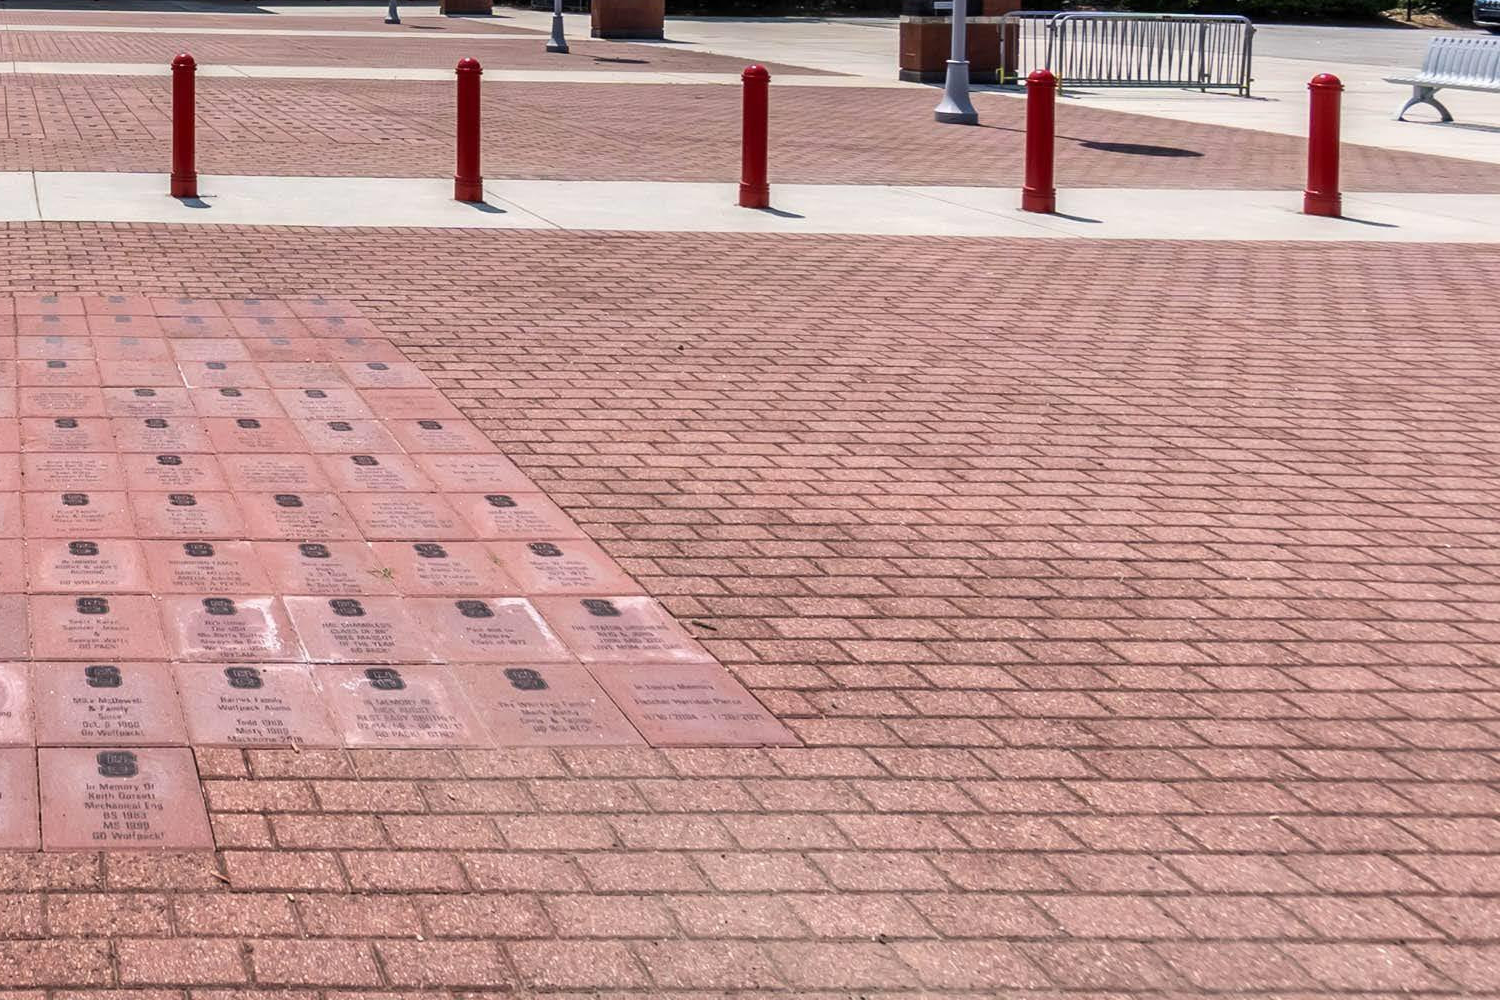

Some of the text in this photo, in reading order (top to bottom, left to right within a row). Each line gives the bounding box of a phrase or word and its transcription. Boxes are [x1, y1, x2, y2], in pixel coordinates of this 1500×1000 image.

[84, 802, 163, 811] Mechanical Eng
[92, 832, 164, 841] GO Wolfpack!
